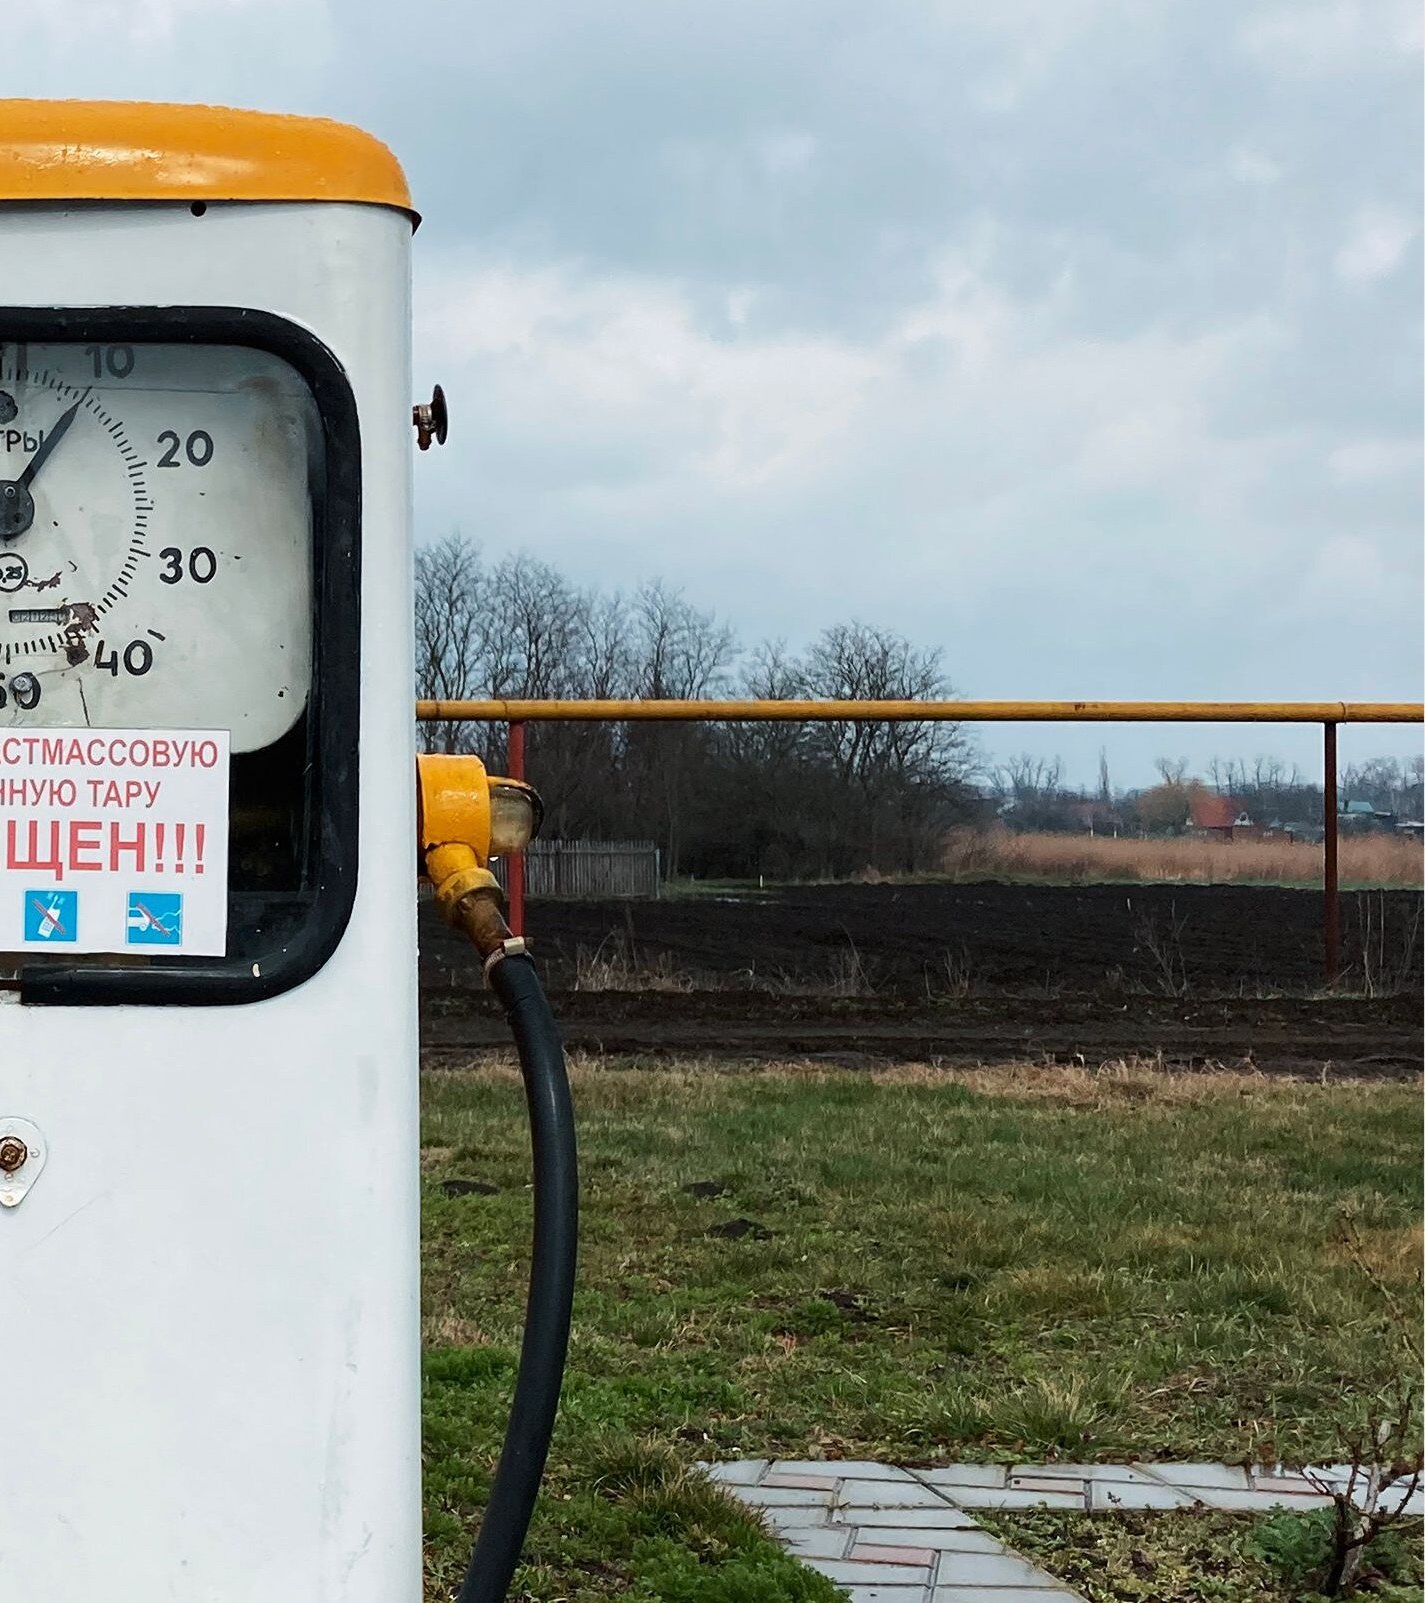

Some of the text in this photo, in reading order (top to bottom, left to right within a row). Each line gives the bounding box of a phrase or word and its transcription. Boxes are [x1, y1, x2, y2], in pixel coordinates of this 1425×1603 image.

[84, 344, 135, 379] 10
[156, 430, 215, 468] 20
[158, 547, 217, 585] 30
[93, 640, 154, 678] 40
[88, 780, 161, 809] ТАРУ
